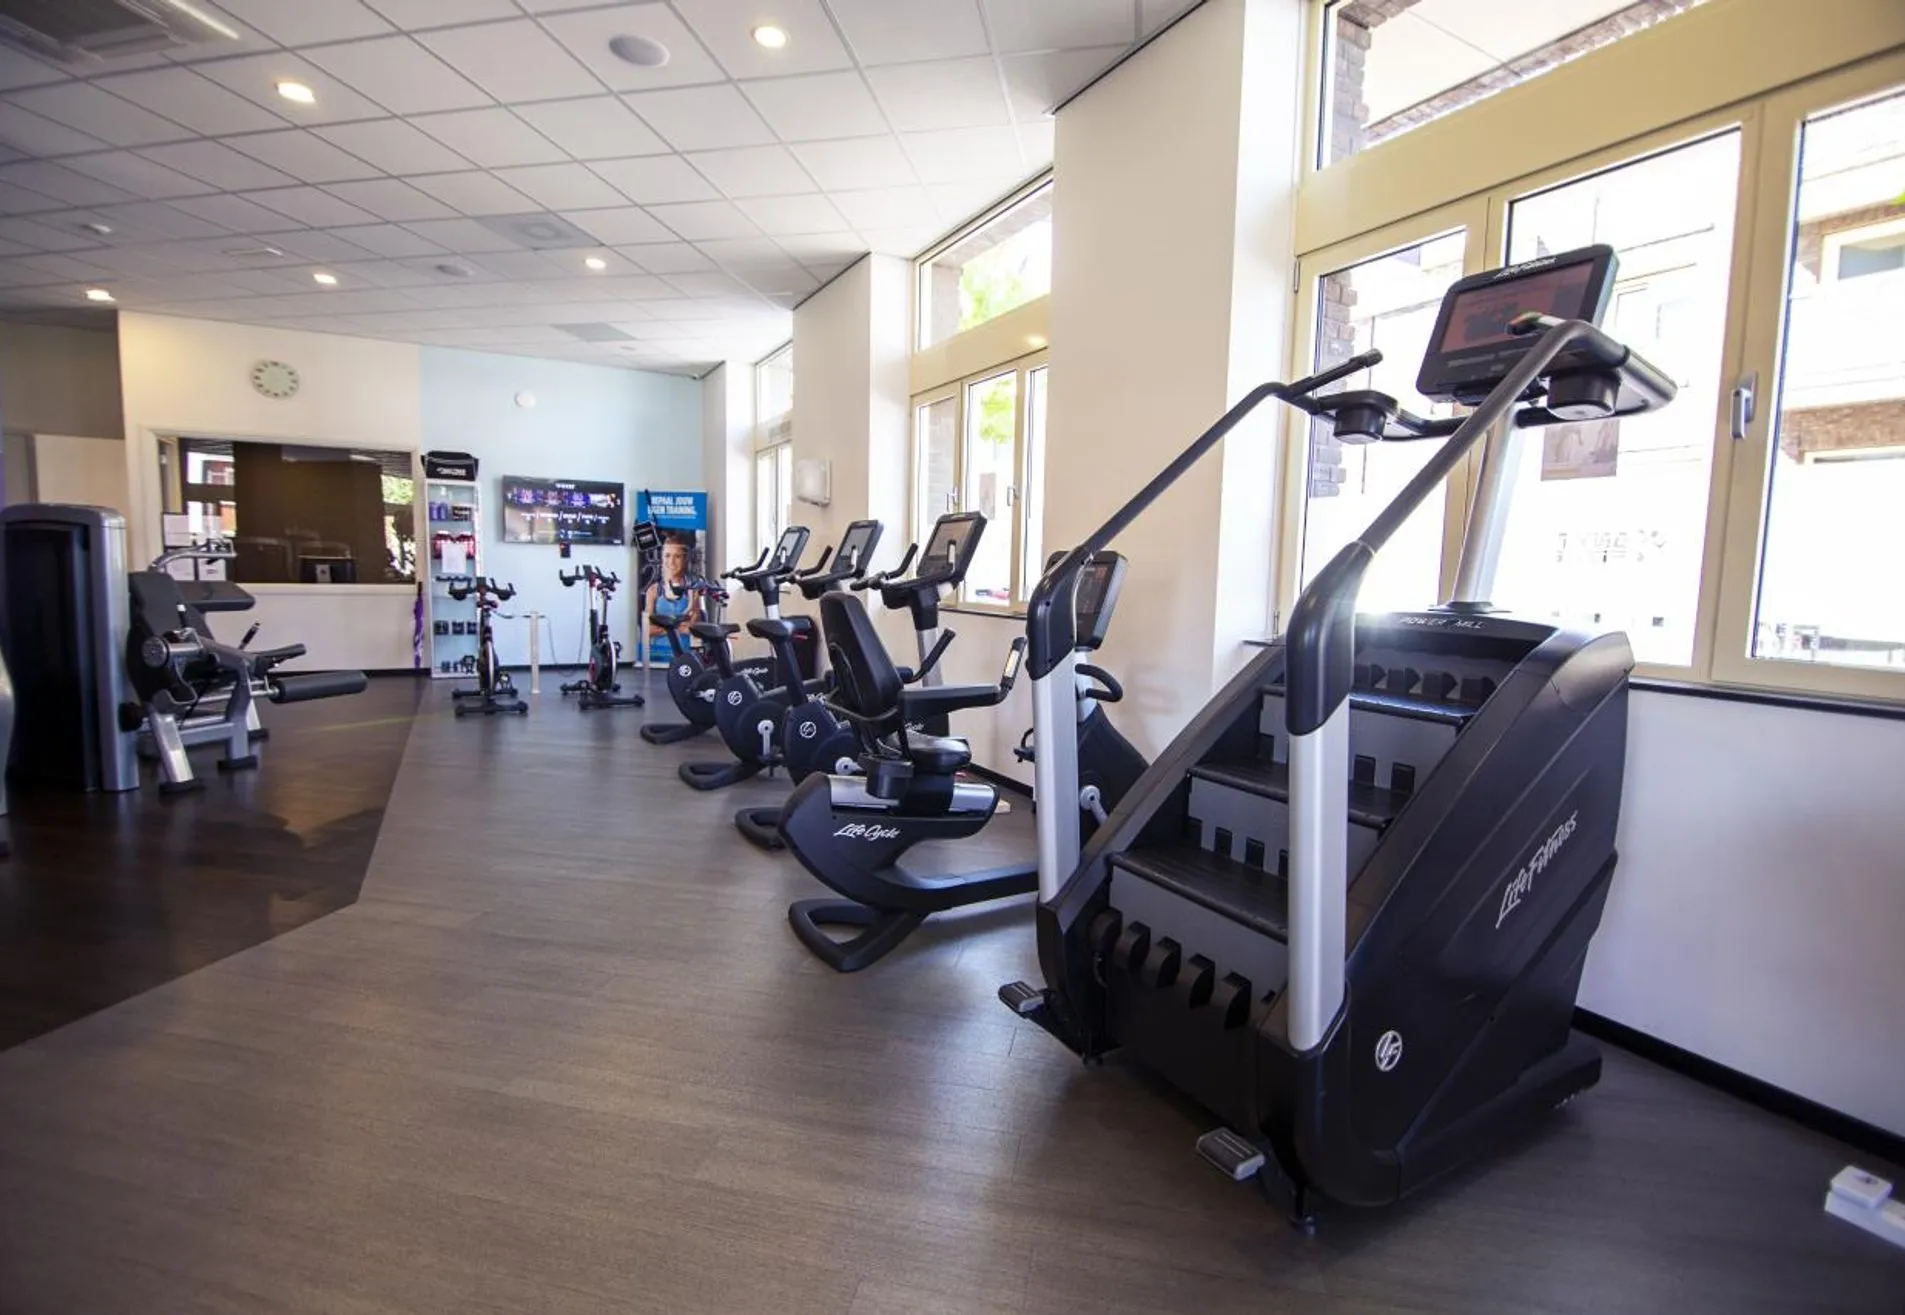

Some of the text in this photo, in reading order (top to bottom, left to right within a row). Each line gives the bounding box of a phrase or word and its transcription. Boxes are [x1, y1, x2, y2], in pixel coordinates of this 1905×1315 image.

[833, 823, 901, 841] Life Cycle
[1495, 810, 1579, 929] Life Fitness
